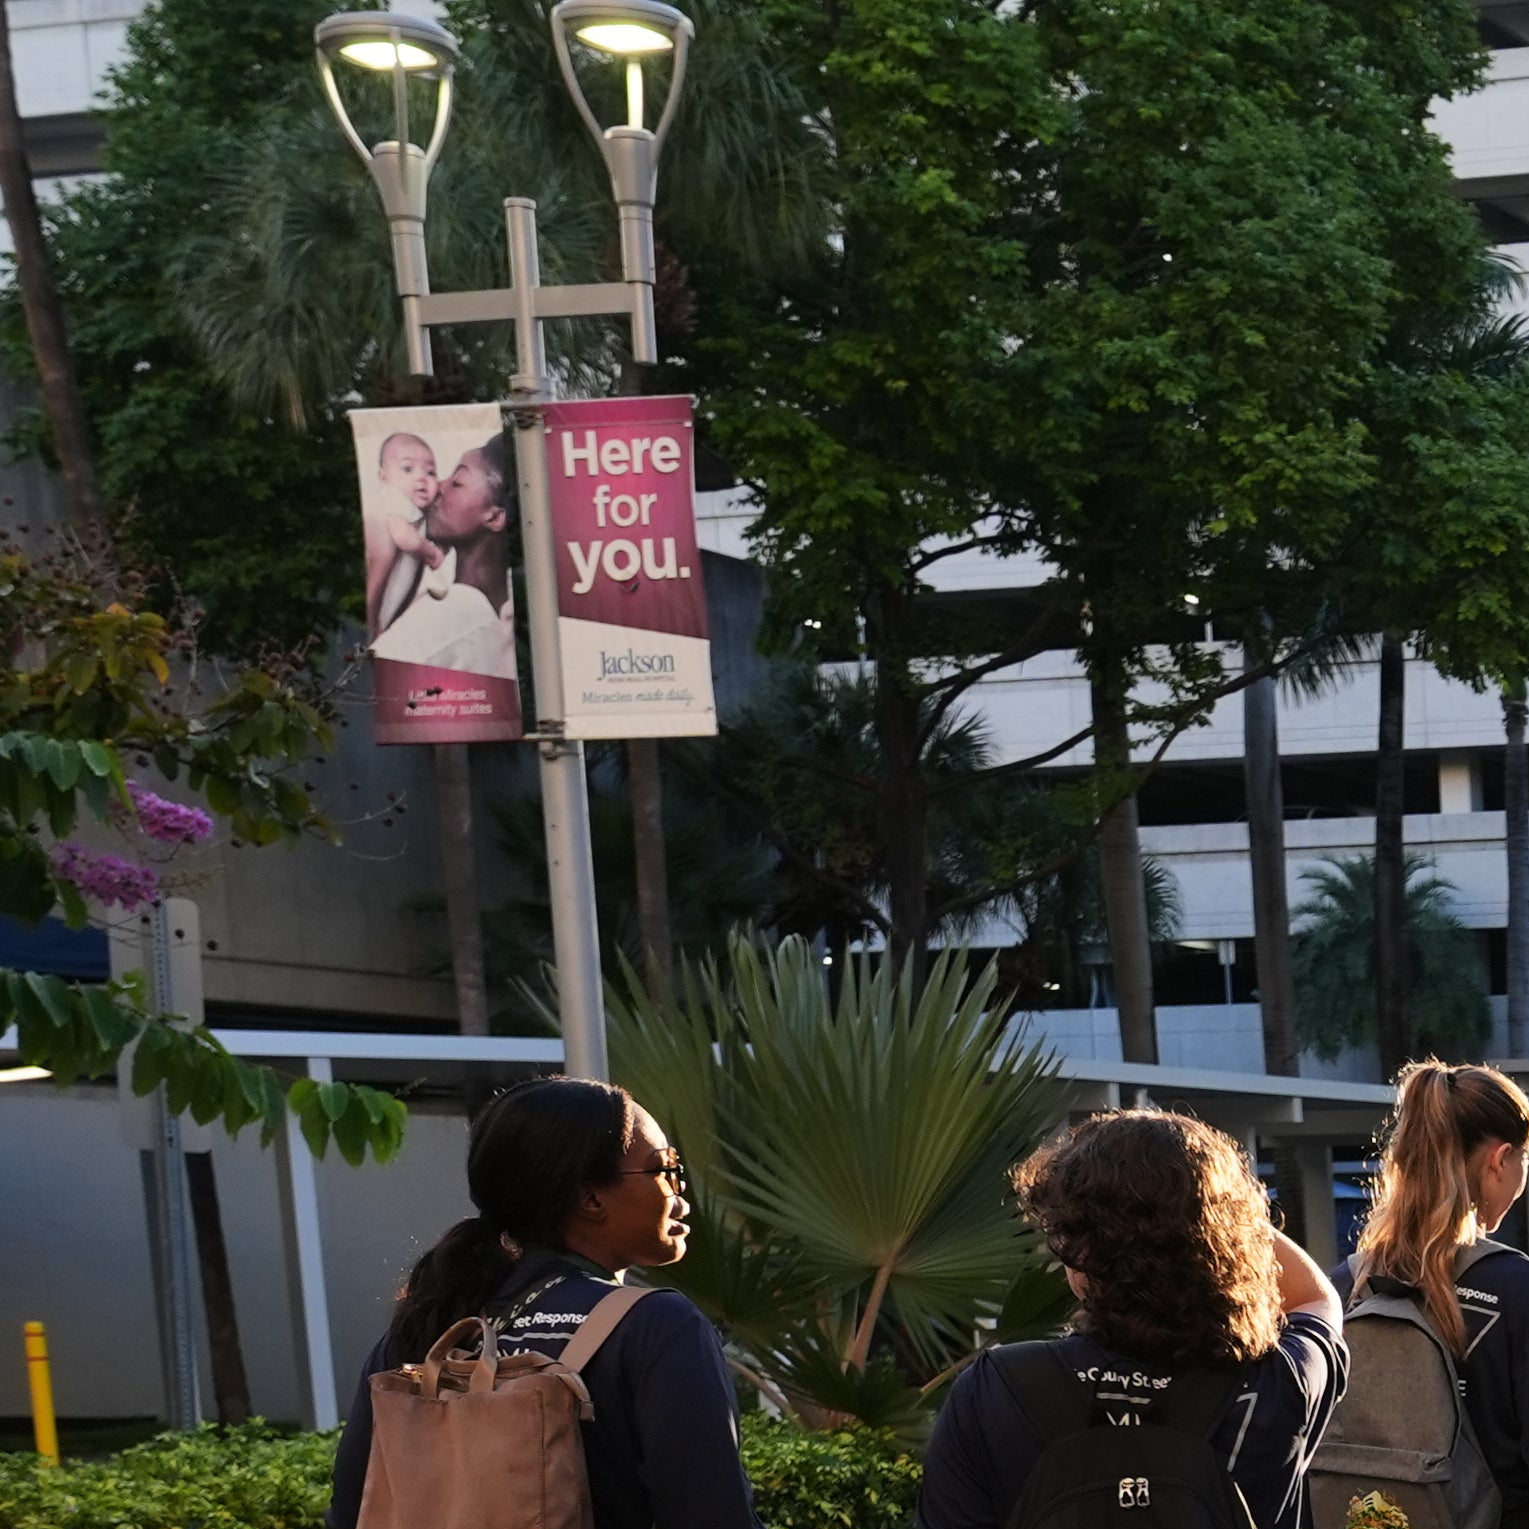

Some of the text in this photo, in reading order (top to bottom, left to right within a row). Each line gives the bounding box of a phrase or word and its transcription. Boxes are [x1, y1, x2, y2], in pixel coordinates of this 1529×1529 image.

[561, 430, 682, 477] Here
[593, 484, 658, 528] for
[567, 537, 692, 595] you.
[596, 648, 675, 681] Jackson
[1455, 1285, 1499, 1304] esponse
[532, 1312, 588, 1328] Respons
[1132, 1372, 1173, 1389] Stee
